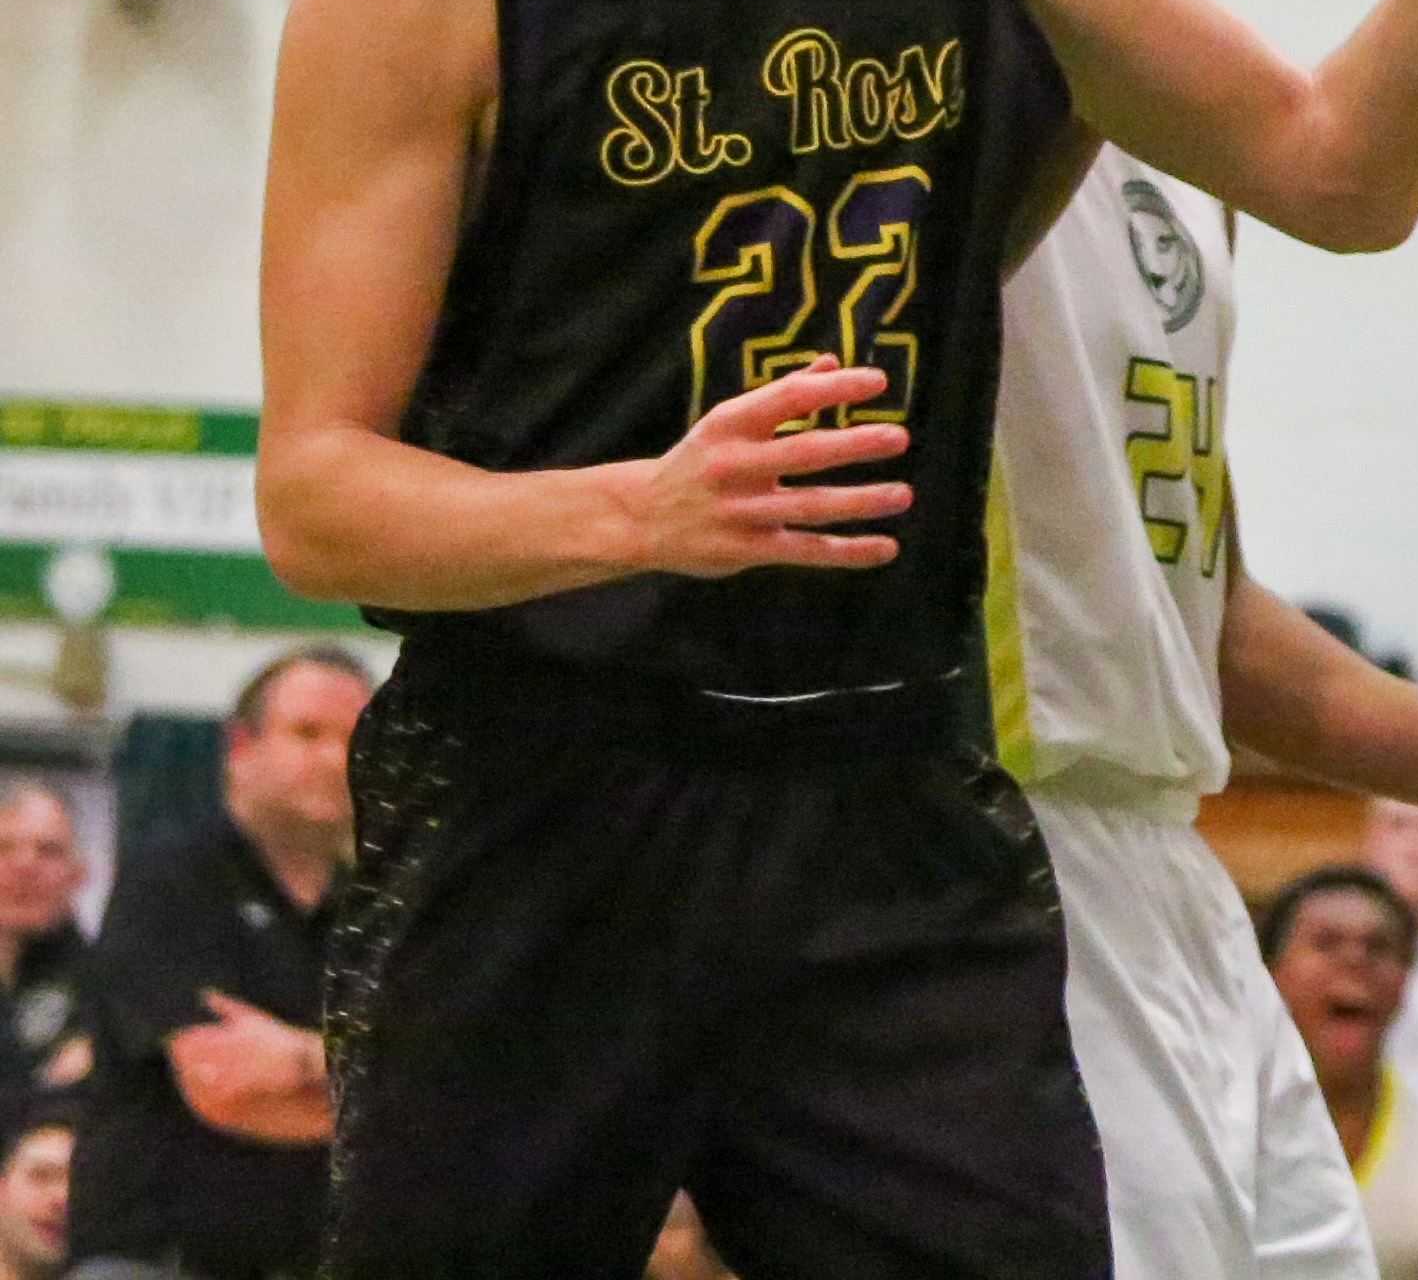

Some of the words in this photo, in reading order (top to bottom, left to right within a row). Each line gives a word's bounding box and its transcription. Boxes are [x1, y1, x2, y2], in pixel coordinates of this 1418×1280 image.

[601, 59, 753, 187] St.
[690, 165, 932, 434] 22
[1124, 355, 1226, 579] 24
